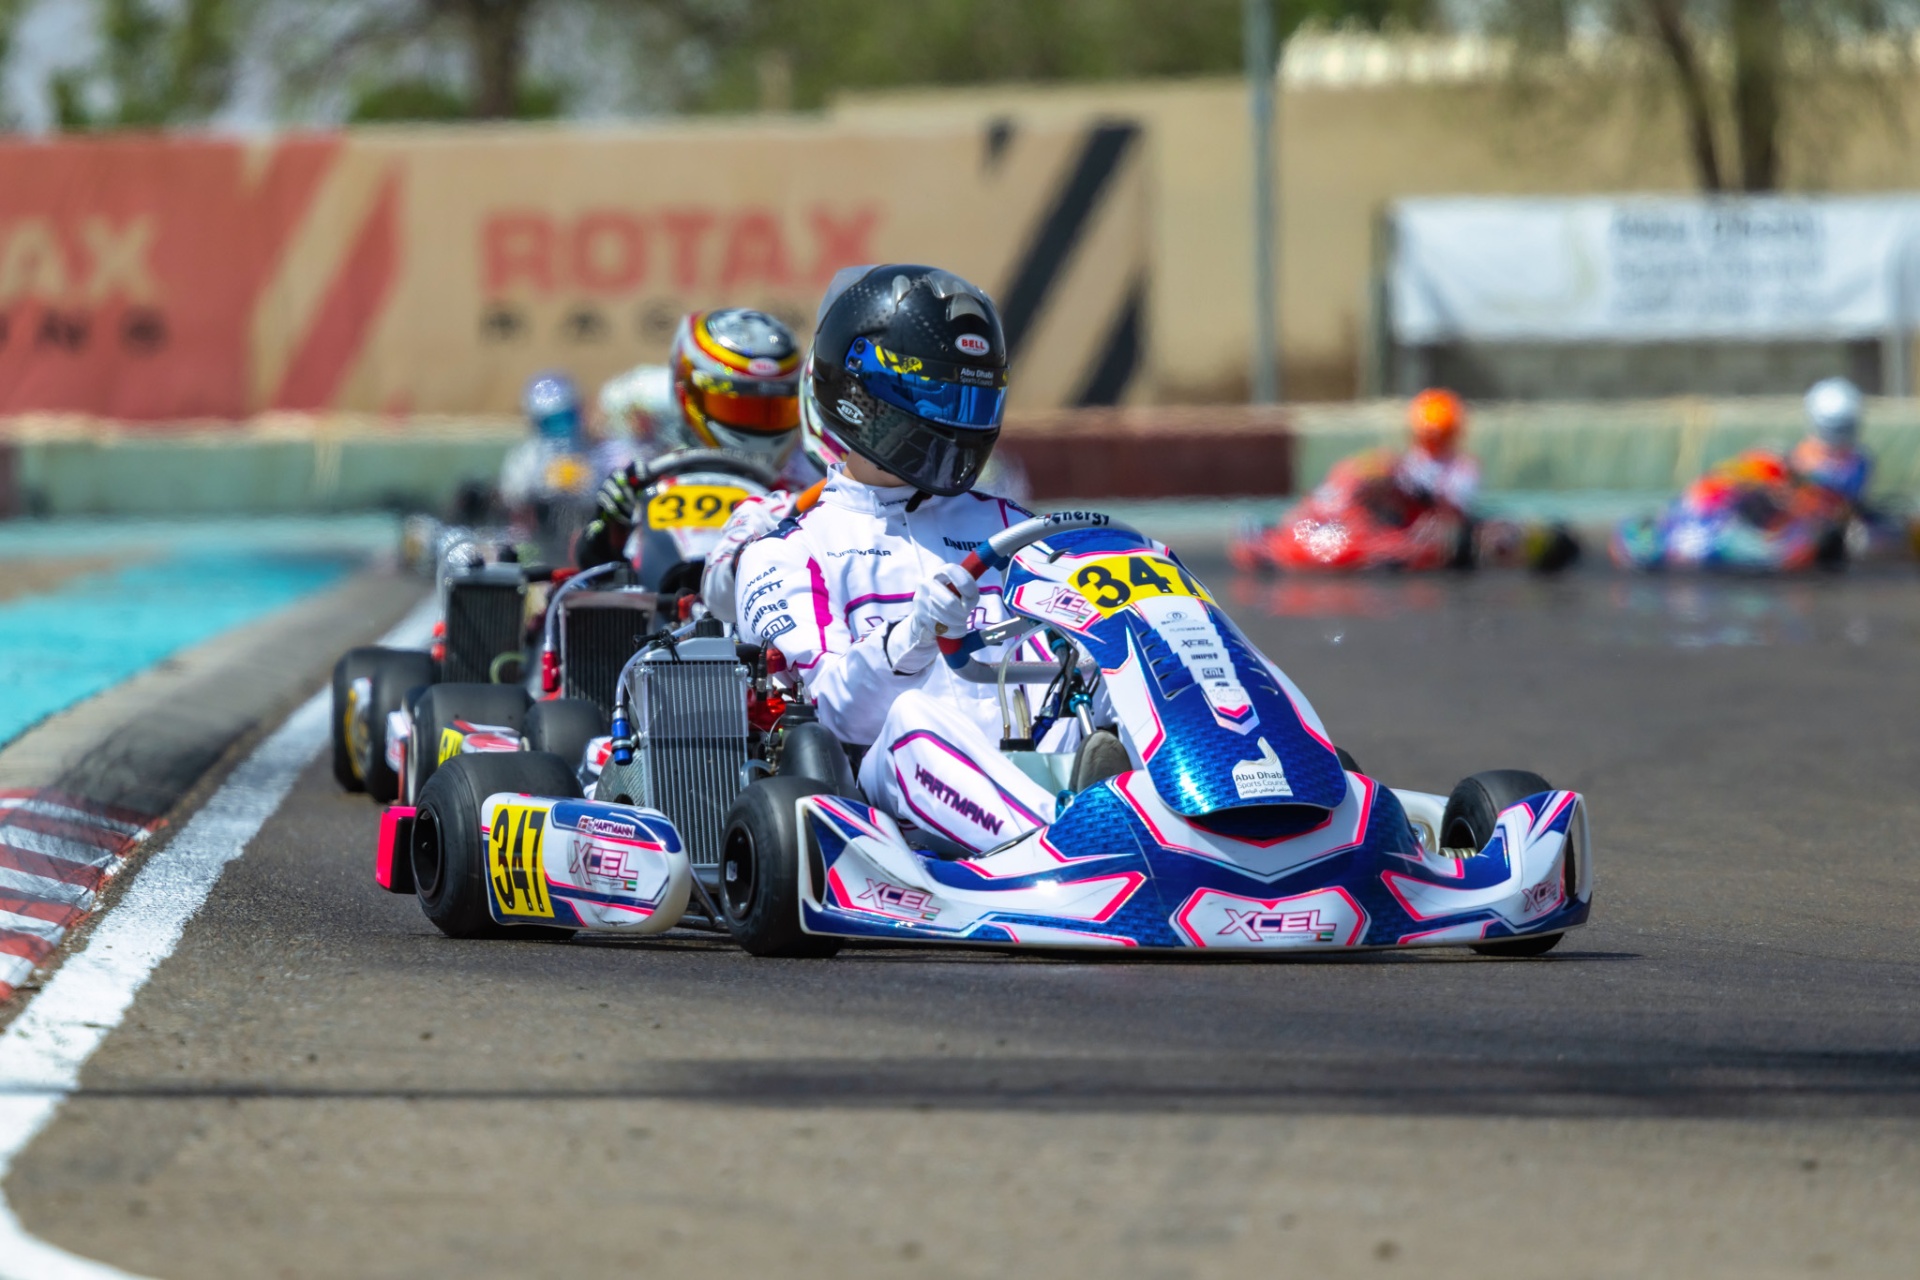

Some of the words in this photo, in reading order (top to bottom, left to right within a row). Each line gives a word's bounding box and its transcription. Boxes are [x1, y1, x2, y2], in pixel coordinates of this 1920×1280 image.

[481, 209, 880, 298] ROTAX
[961, 338, 985, 350] BELL
[961, 368, 976, 377] Abu
[826, 548, 892, 558] PUREWEAR
[1076, 556, 1201, 609] 347
[1036, 585, 1094, 617] XCEL
[1235, 774, 1255, 782] Abu
[1238, 781, 1262, 790] Sports
[915, 763, 1005, 836] HARTMANN
[594, 820, 633, 836] HARTMANN
[492, 808, 547, 913] 347
[569, 840, 638, 885] XCEL
[857, 877, 941, 914] XCEL
[1216, 908, 1337, 941] XCEL
